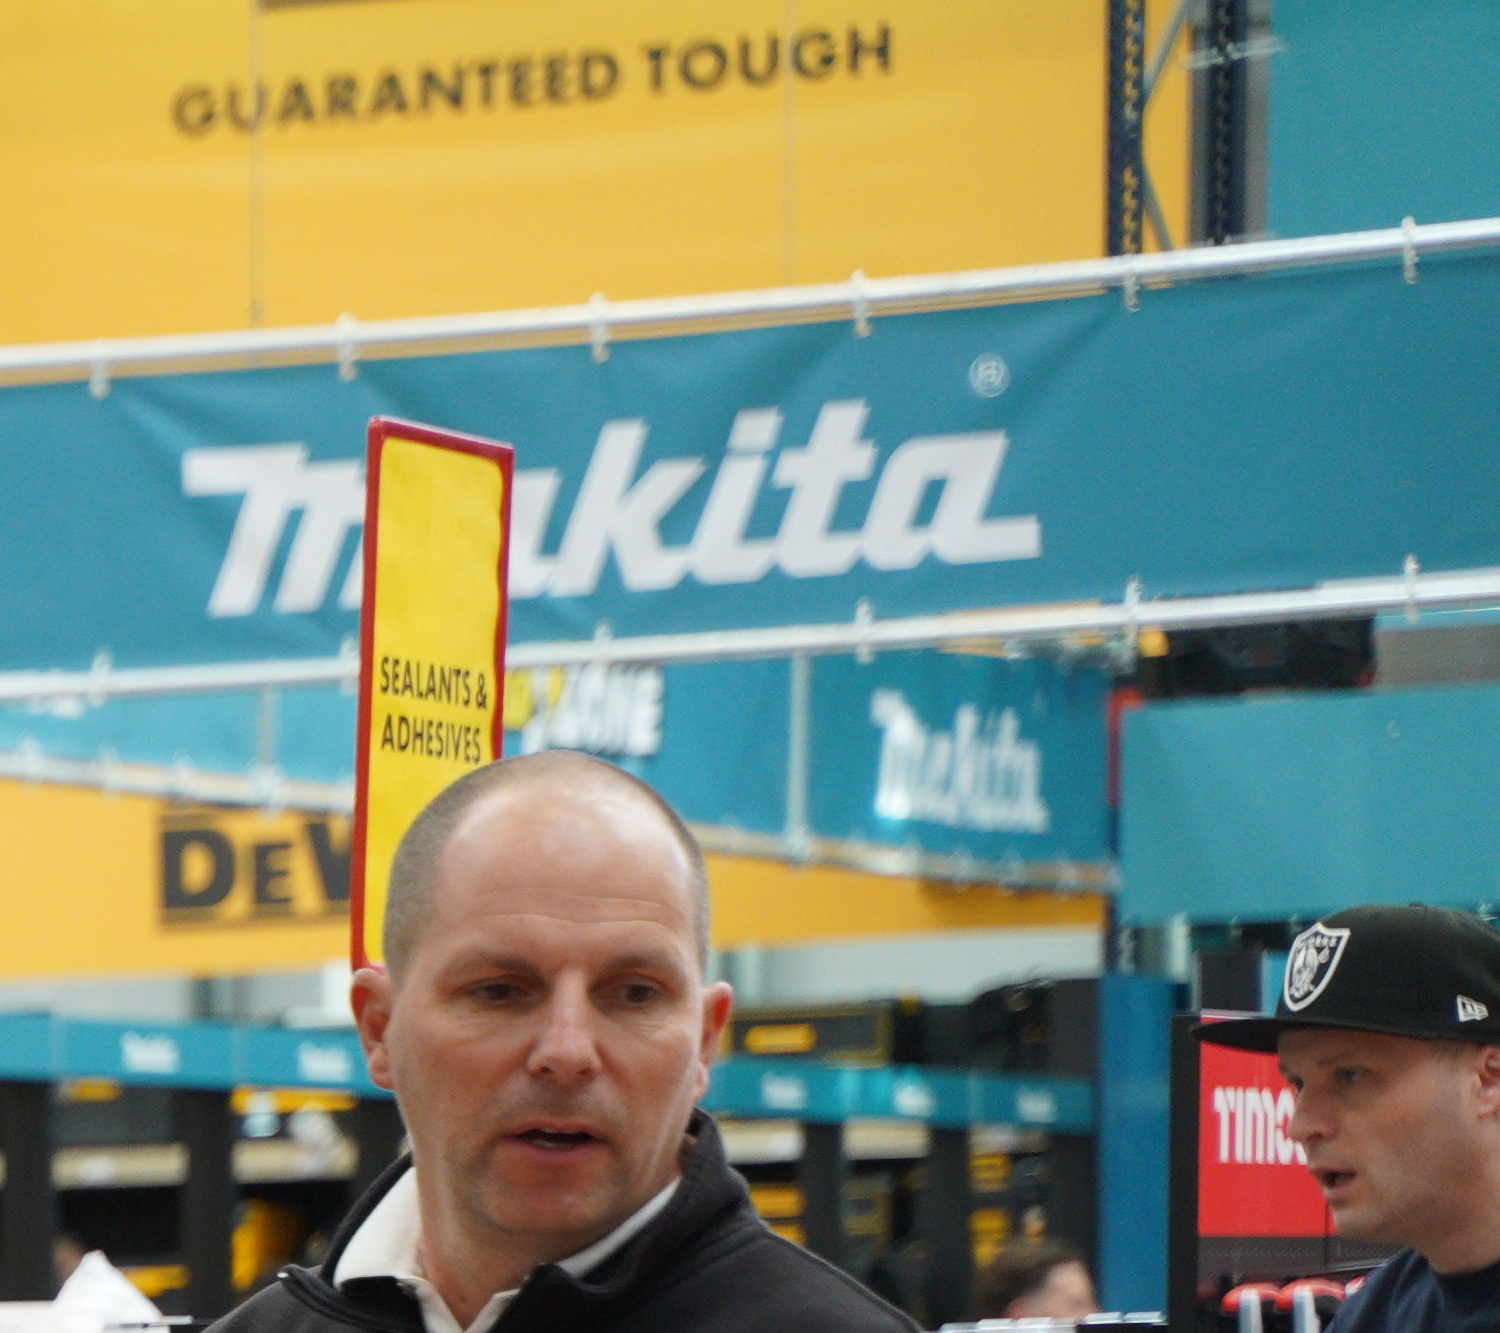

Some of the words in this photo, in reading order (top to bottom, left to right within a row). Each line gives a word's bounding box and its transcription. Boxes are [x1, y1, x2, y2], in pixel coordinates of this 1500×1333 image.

[172, 49, 618, 135] GUARANTEED
[644, 23, 896, 94] TOUGH
[379, 655, 469, 707] SEALANTS
[472, 672, 489, 712] &
[380, 712, 483, 766] ADHESIVES
